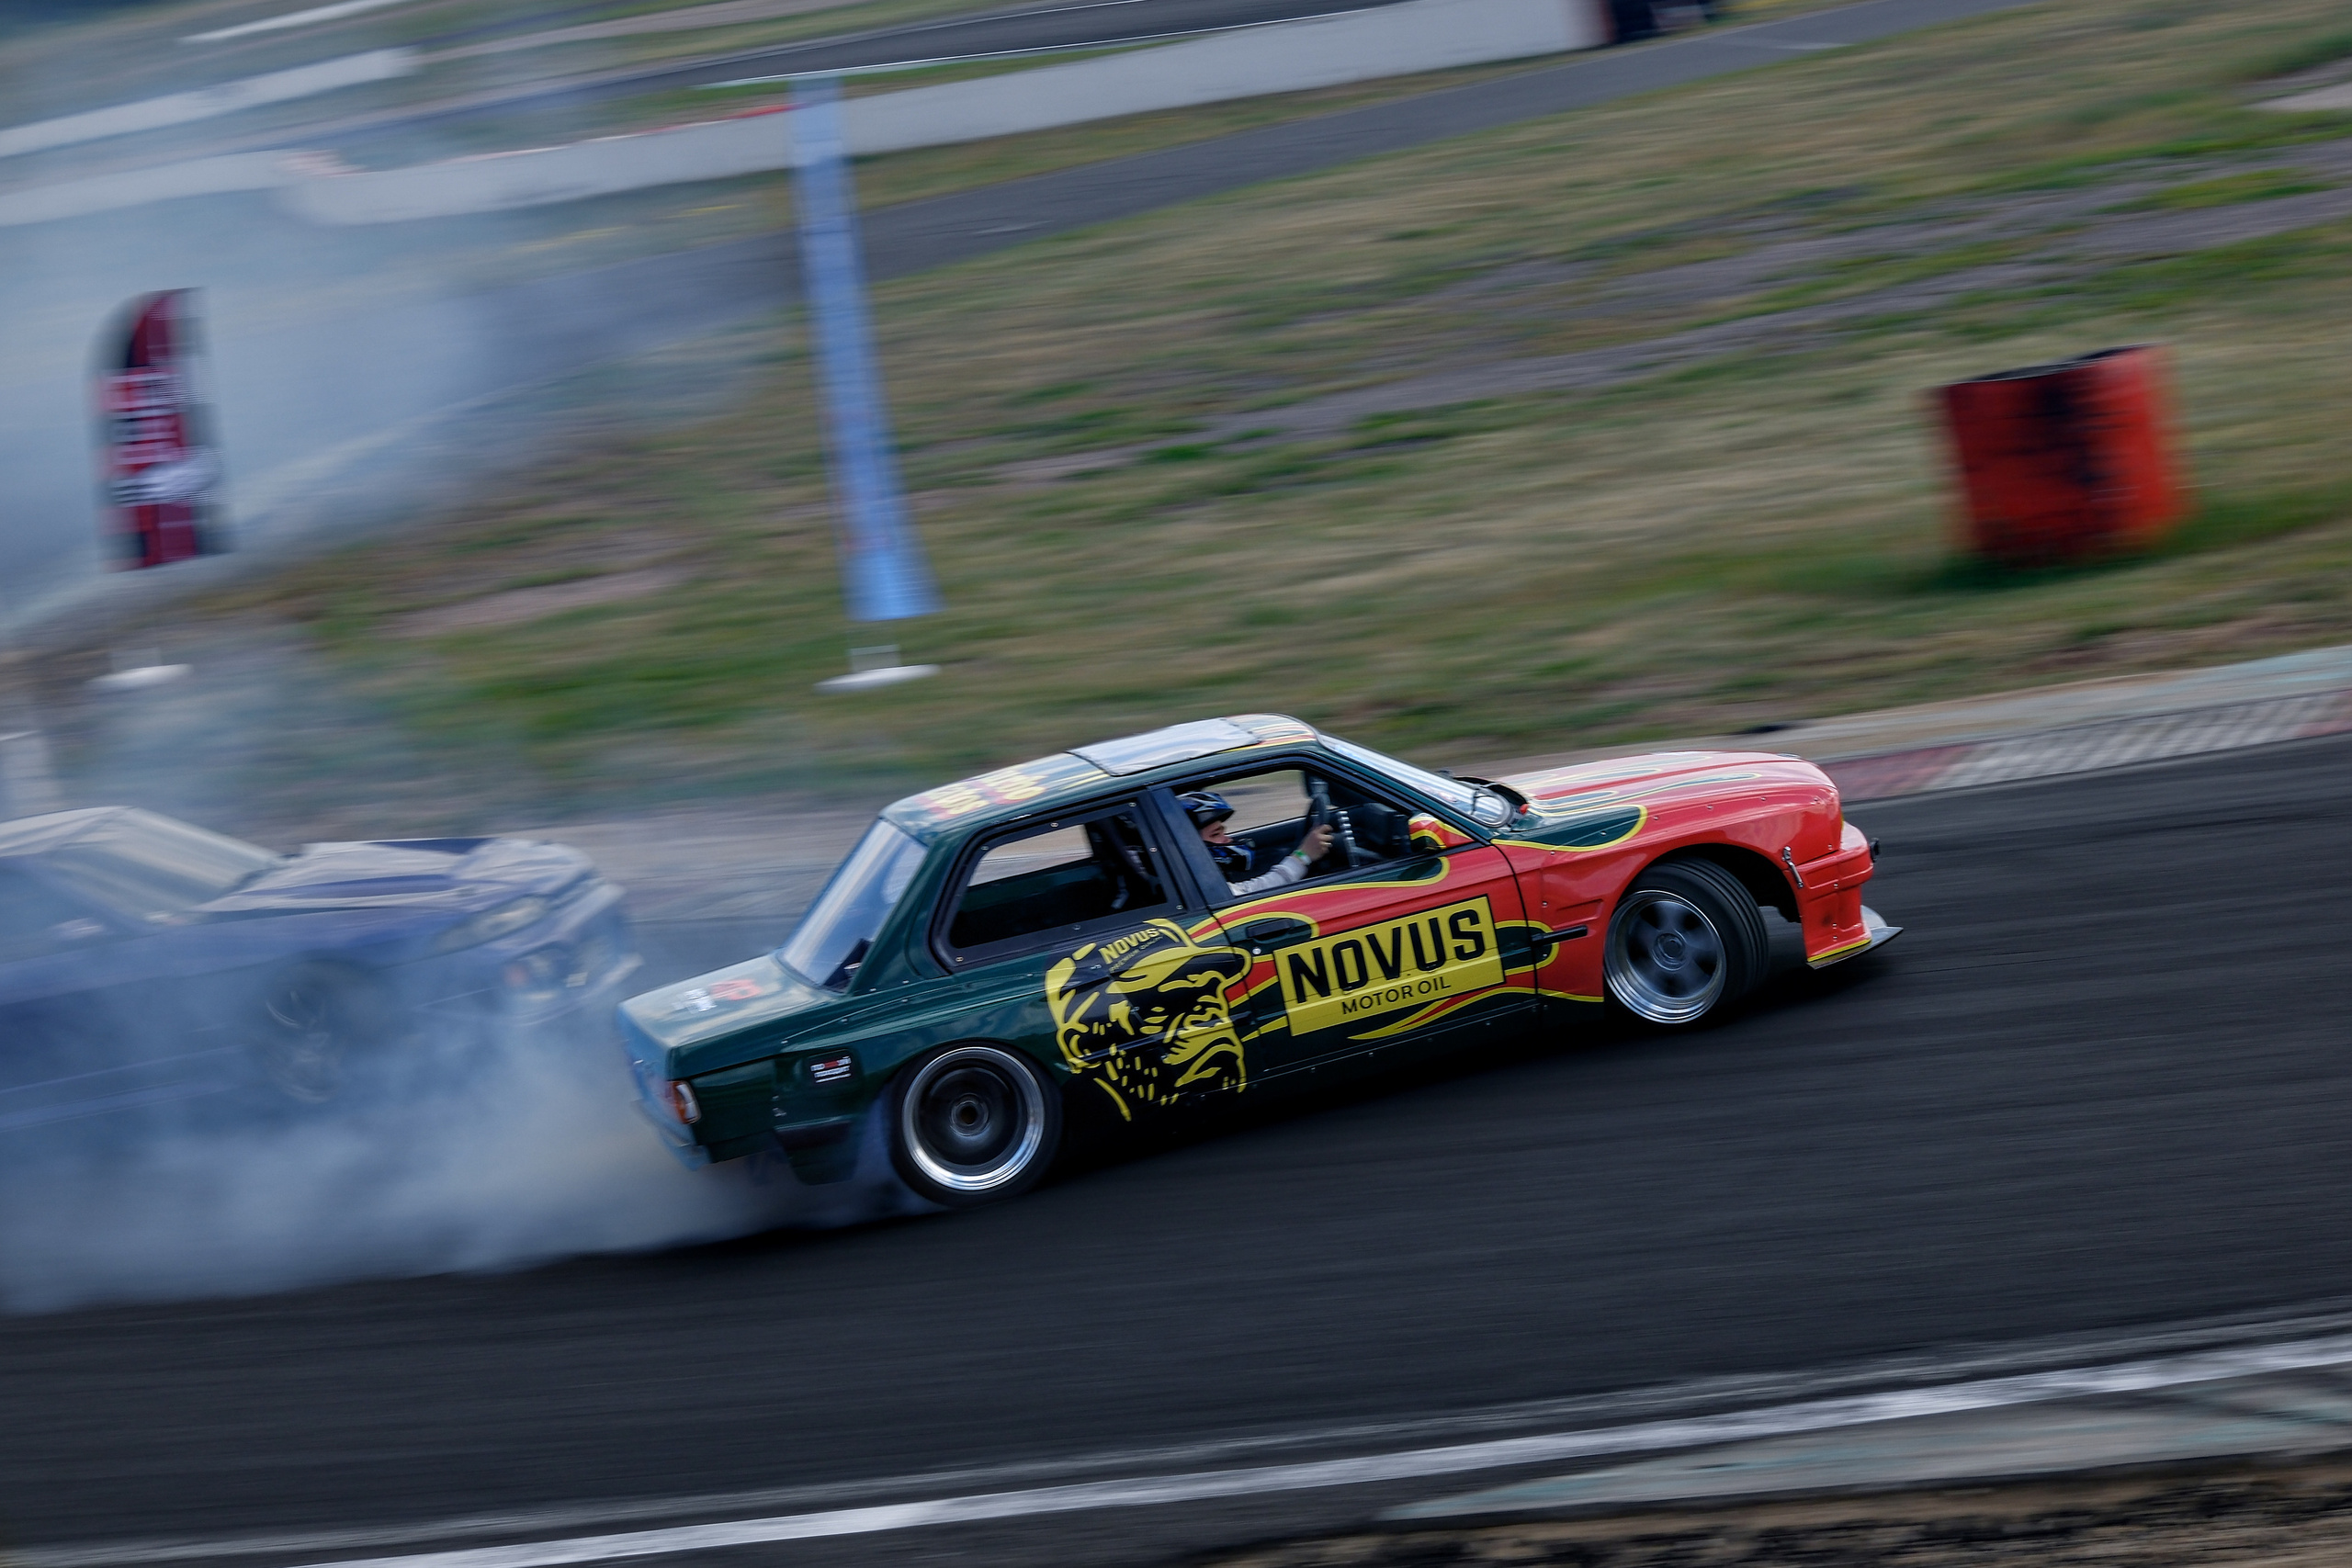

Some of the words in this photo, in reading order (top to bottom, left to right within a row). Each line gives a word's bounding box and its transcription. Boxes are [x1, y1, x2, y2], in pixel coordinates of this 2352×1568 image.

[1099, 928, 1159, 964] NOVUS
[1288, 908, 1486, 1004] NOVUS
[1341, 985, 1414, 1015] MOTOR
[1418, 976, 1451, 995] OIL
